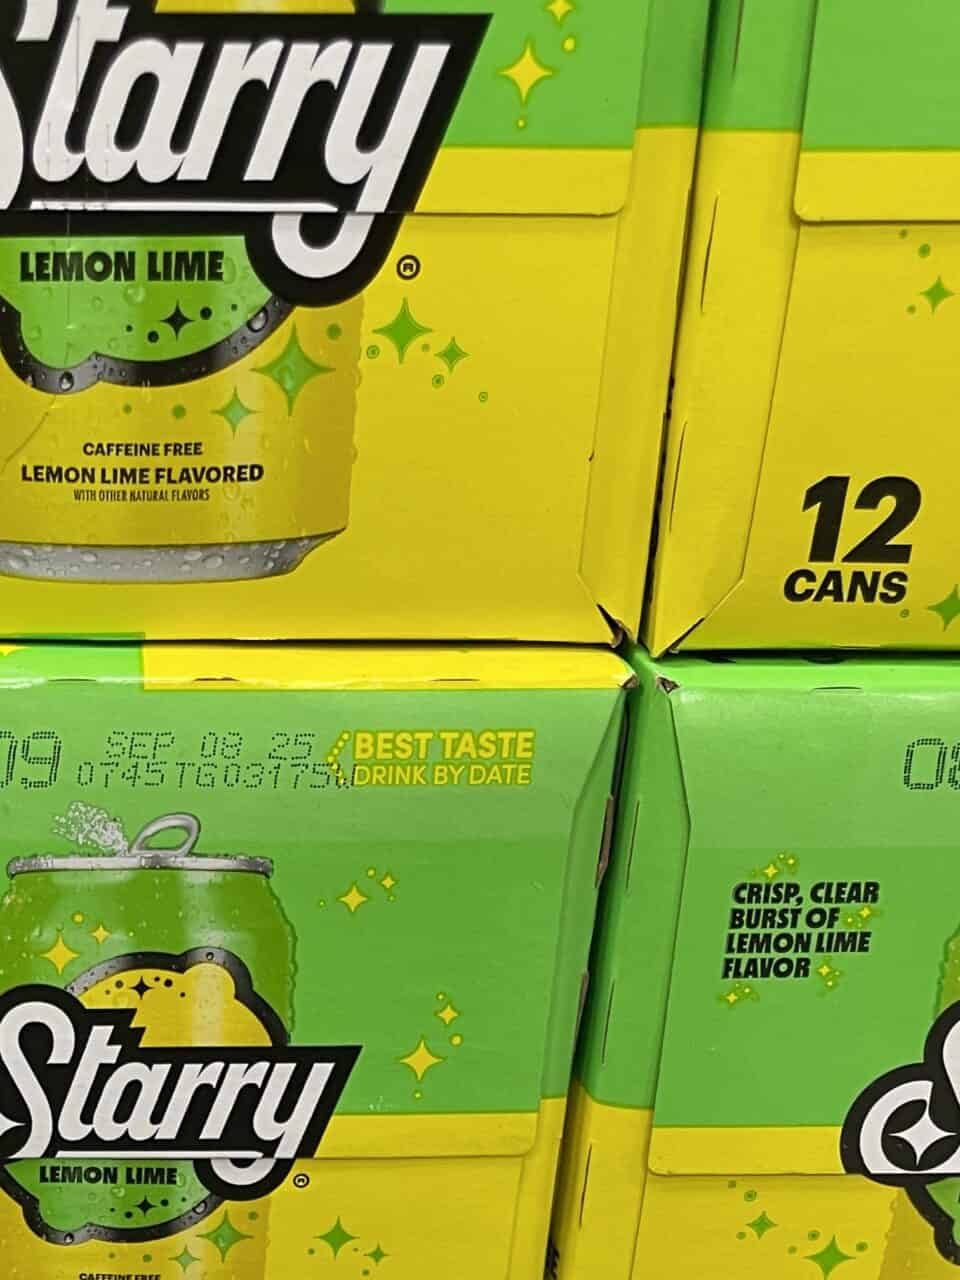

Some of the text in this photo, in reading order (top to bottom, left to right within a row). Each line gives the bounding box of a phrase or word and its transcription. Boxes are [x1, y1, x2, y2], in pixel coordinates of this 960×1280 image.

[20, 251, 225, 282] LEMON LIME
[82, 442, 203, 457] CAFFEINE FREE
[21, 463, 265, 485] LEMON LIME FLAVORED
[73, 487, 211, 502] WITH OTHER NATURAL FLAVORS
[802, 475, 922, 564] 12
[783, 568, 910, 605] CANS
[105, 730, 316, 760] SEP 08 25
[354, 731, 535, 760] BEST TASTE
[354, 763, 532, 786] DRINK BY DATE
[733, 881, 880, 906] CRISP, CLEAR
[730, 907, 841, 930] BURST OF
[725, 931, 873, 954] LEMON LIME
[722, 957, 811, 979] FLAVOR
[39, 1164, 178, 1185] LEMON LIME
